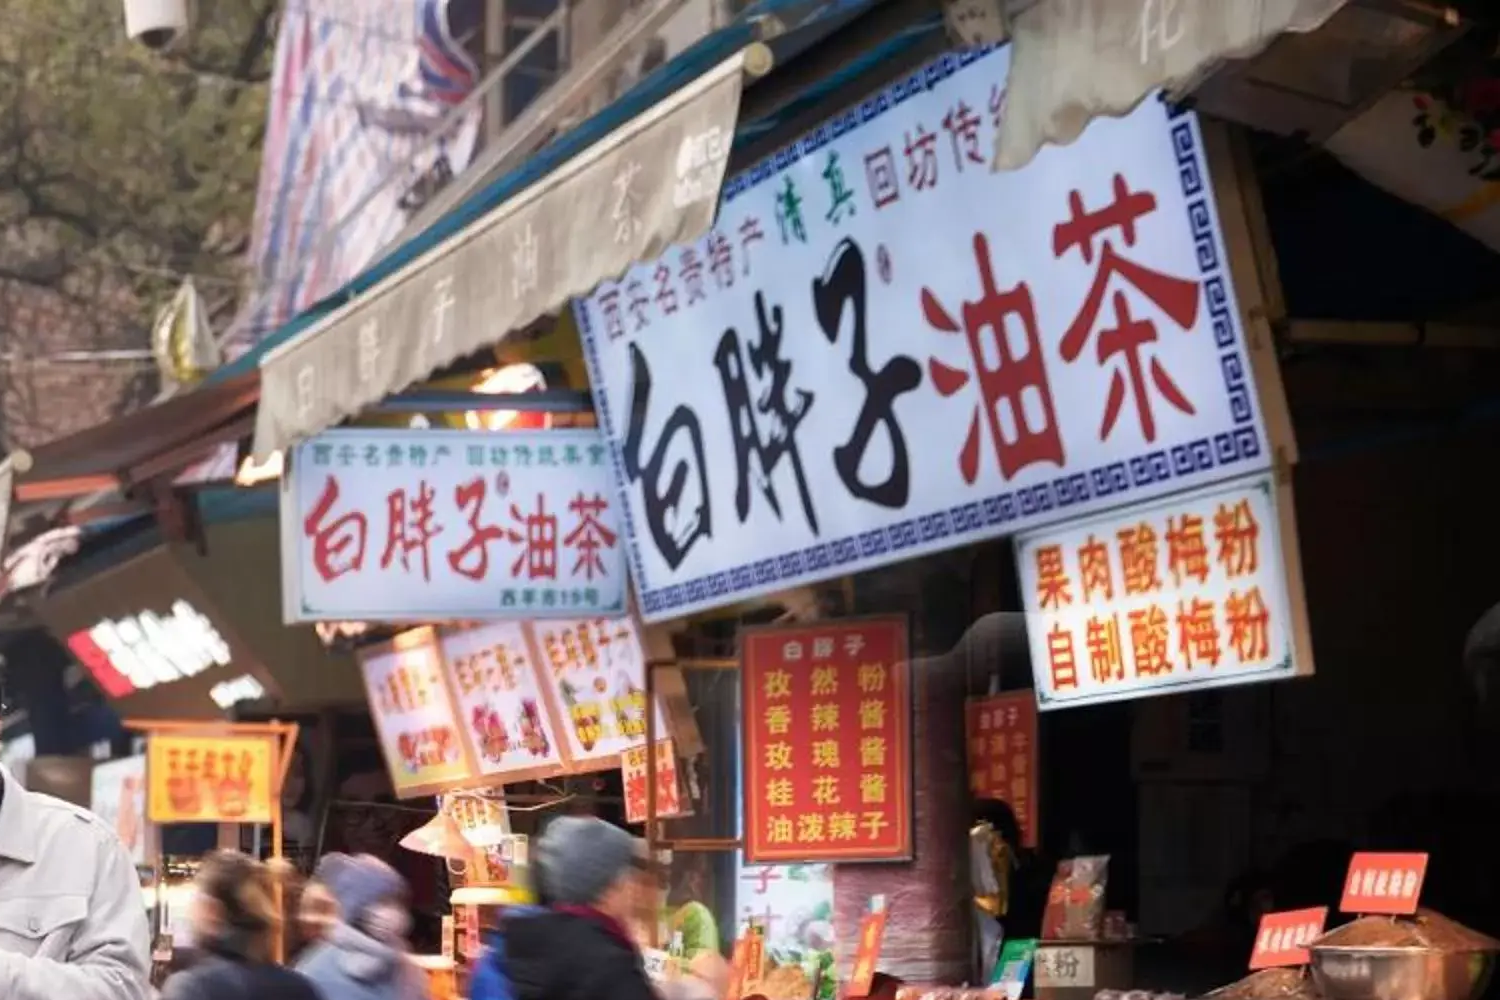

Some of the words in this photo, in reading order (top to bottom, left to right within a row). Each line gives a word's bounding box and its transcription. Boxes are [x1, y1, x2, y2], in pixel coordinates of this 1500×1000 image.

[775, 149, 858, 246] 清真
[621, 172, 1201, 572] 白胖子油茶
[303, 473, 618, 583] 白胖子油茶
[1034, 497, 1259, 610] 果肉酸梅粉
[782, 633, 867, 661] 白胖子
[1046, 584, 1271, 691] 自制酸梅粉
[763, 662, 887, 699] 孜然粉
[764, 699, 887, 735] 香辣酱
[764, 735, 888, 772] 玫瑰酱
[765, 772, 888, 808] 桂花酱
[766, 810, 889, 844] 油泼辣子
